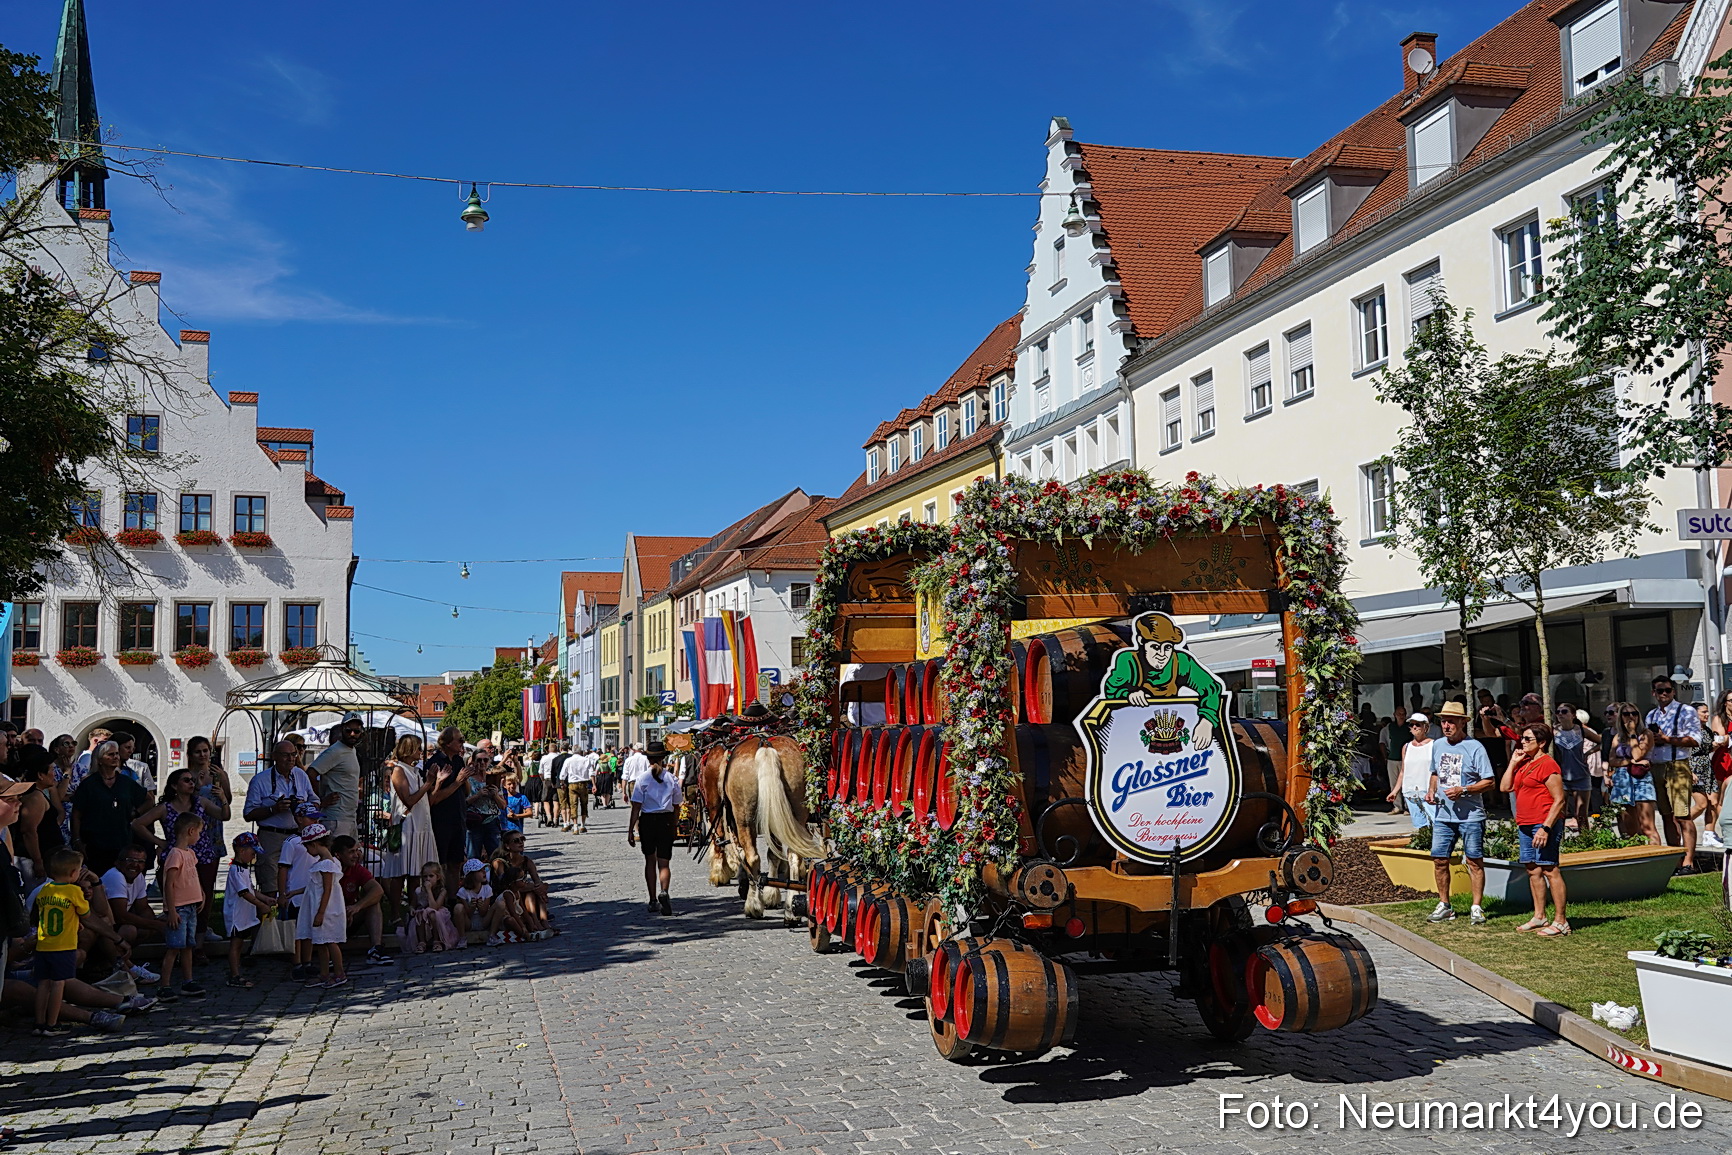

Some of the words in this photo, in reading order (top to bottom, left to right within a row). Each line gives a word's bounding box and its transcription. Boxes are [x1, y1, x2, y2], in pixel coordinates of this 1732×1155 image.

[1111, 749, 1214, 813] Glossner
[1166, 783, 1214, 809] Bier
[1127, 812, 1152, 828] Der
[1153, 811, 1205, 830] hochfeine
[1134, 827, 1199, 846] Biergenuss
[39, 907, 64, 937] 10
